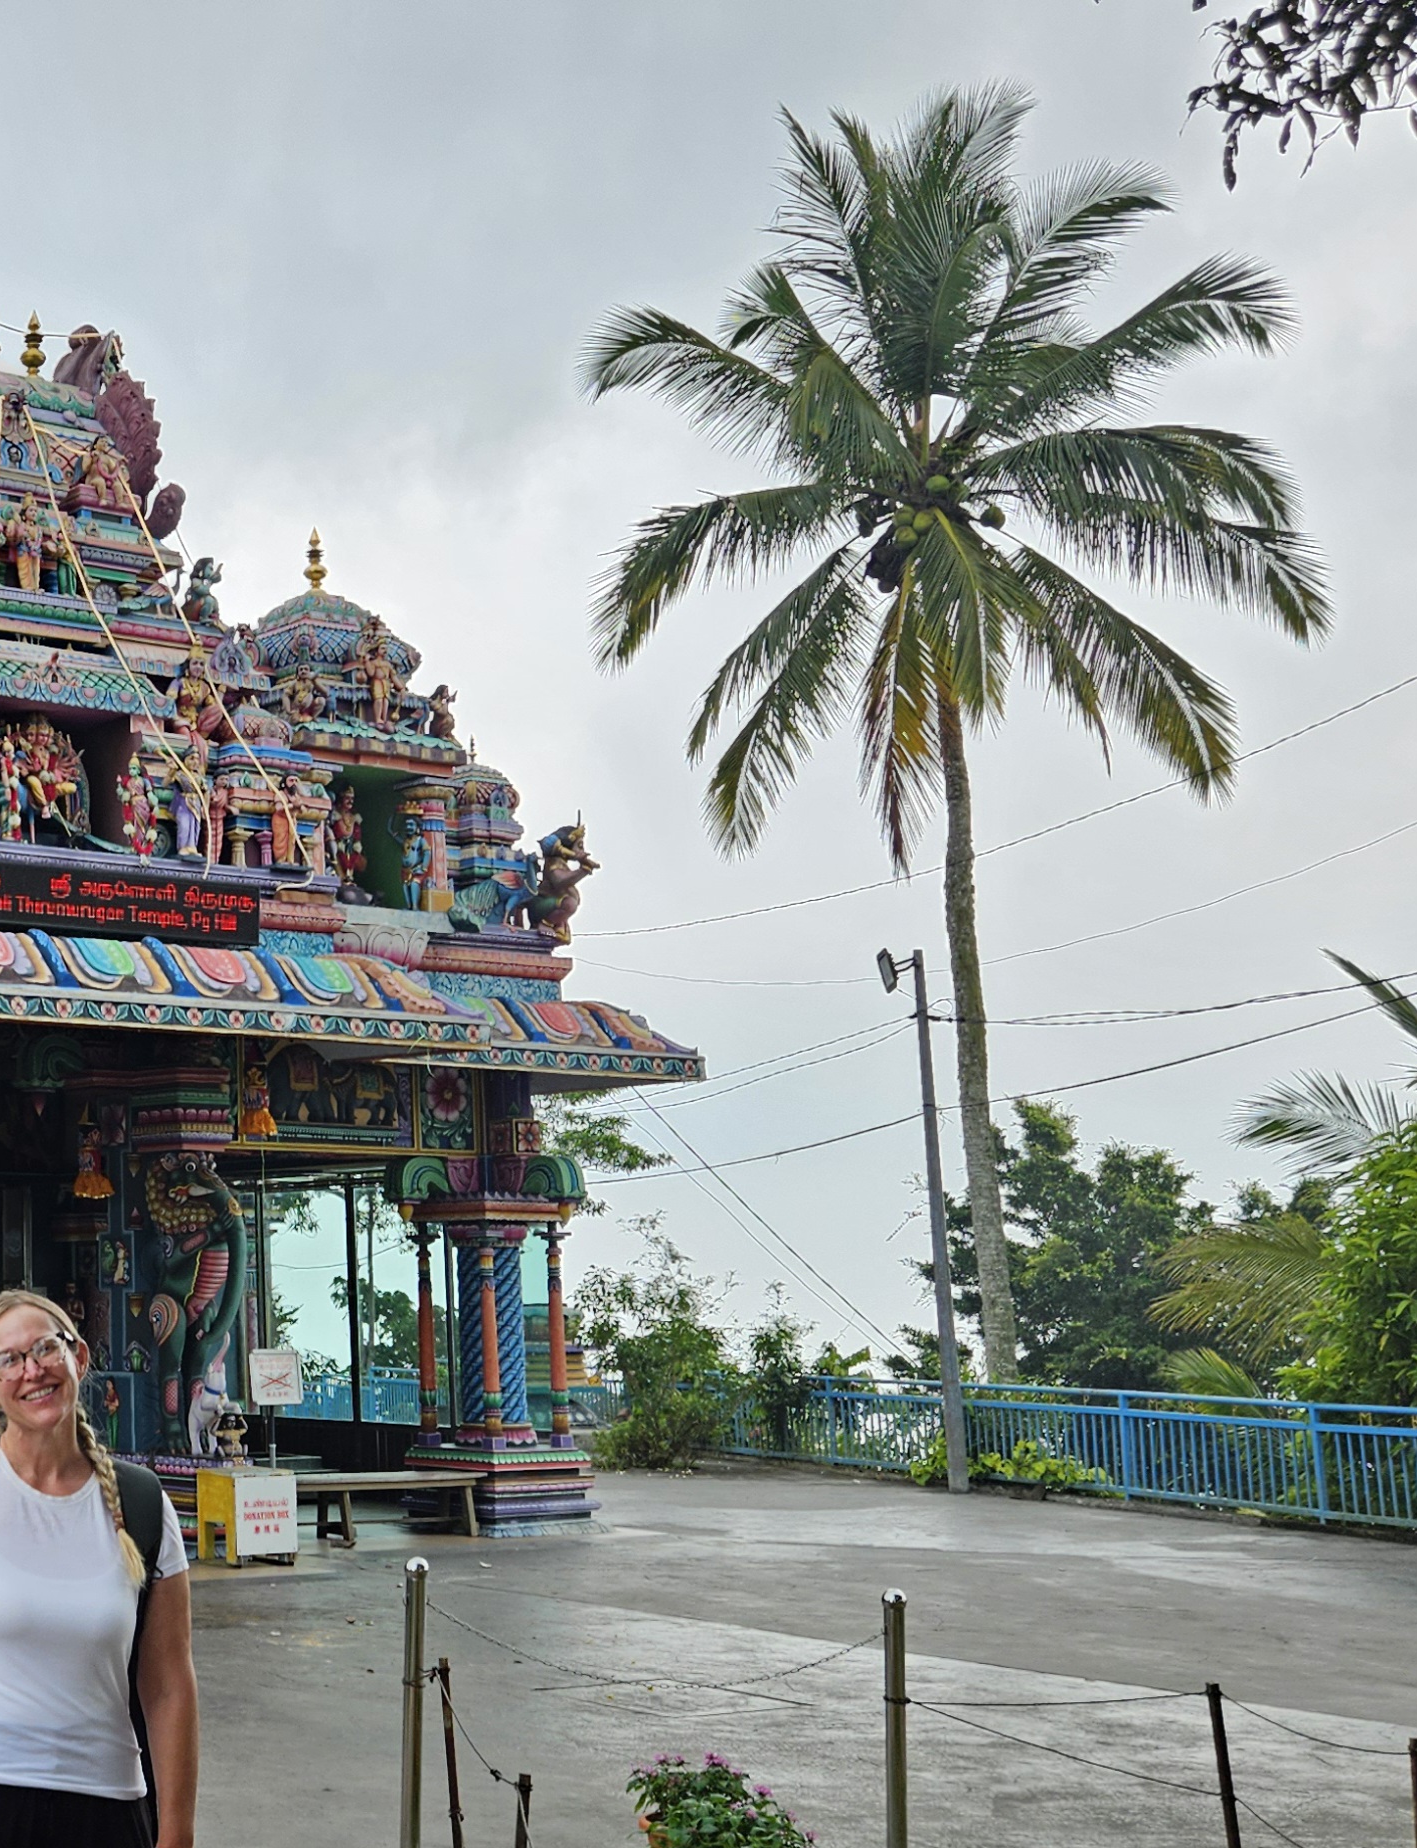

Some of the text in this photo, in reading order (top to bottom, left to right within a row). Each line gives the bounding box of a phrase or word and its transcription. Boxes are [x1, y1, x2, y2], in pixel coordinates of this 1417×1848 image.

[15, 895, 125, 924] Thirumurugan
[191, 911, 210, 932] Pg
[215, 913, 237, 931] Hill
[243, 1509, 289, 1521] DONATION BOX
